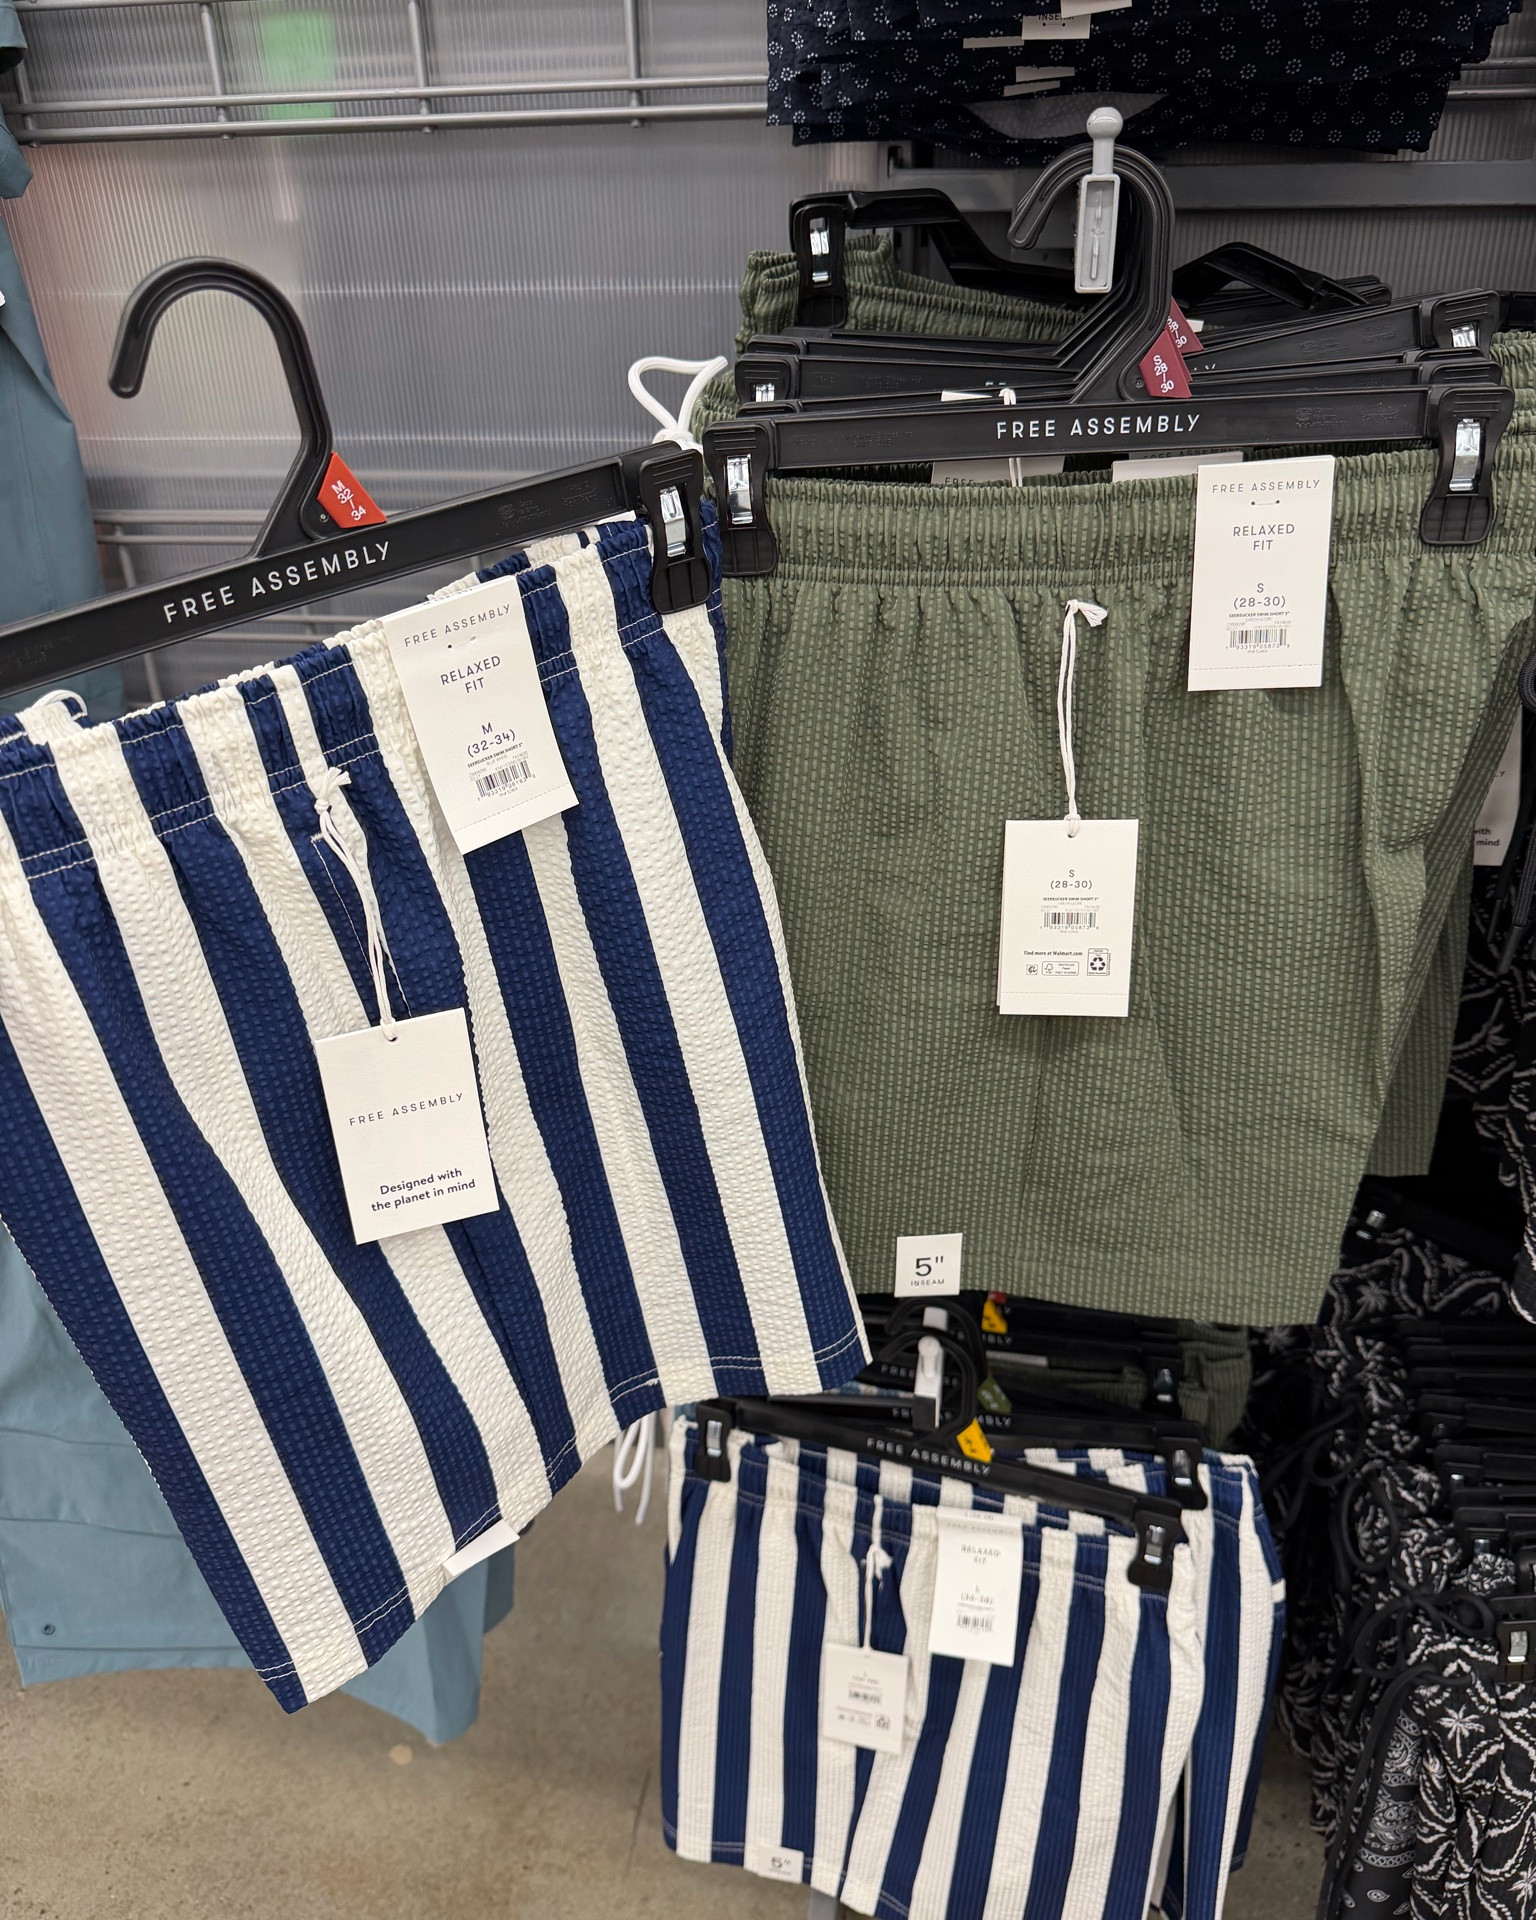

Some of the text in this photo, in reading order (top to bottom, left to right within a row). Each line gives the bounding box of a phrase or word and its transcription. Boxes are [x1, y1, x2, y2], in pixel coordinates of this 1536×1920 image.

[1175, 336, 1187, 348] 30
[1153, 355, 1162, 366] S
[1154, 363, 1168, 377] 28
[1160, 380, 1174, 393] 30
[997, 414, 1200, 439] FREE ASSEMBLY
[332, 480, 345, 494] M
[1212, 479, 1321, 494] FREE ASSEMBLY
[337, 488, 354, 504] 32
[351, 505, 366, 521] 34
[1233, 523, 1295, 537] RELAXED
[1253, 540, 1274, 551] FIT
[163, 585, 235, 624] FREE
[251, 541, 389, 597] ASSEMBLY
[1256, 582, 1264, 593] S
[1233, 595, 1286, 610] (28-30)
[404, 603, 512, 648] FREE ASSEMBLY
[440, 655, 501, 686] RELAXED
[465, 677, 485, 694] FIT
[481, 722, 493, 735] M
[467, 729, 516, 758] (32-34)
[1476, 839, 1500, 847] mind
[1068, 869, 1075, 878] S
[1050, 880, 1093, 890] (28-30)
[349, 1092, 464, 1127] FREE ASSEMBLY
[380, 1168, 463, 1195] Designed with
[371, 1178, 476, 1212] the planet in mind
[915, 1256, 944, 1277] 5"
[910, 1279, 945, 1287] INSEAM
[866, 1437, 991, 1477] FREE ASSEMBLY
